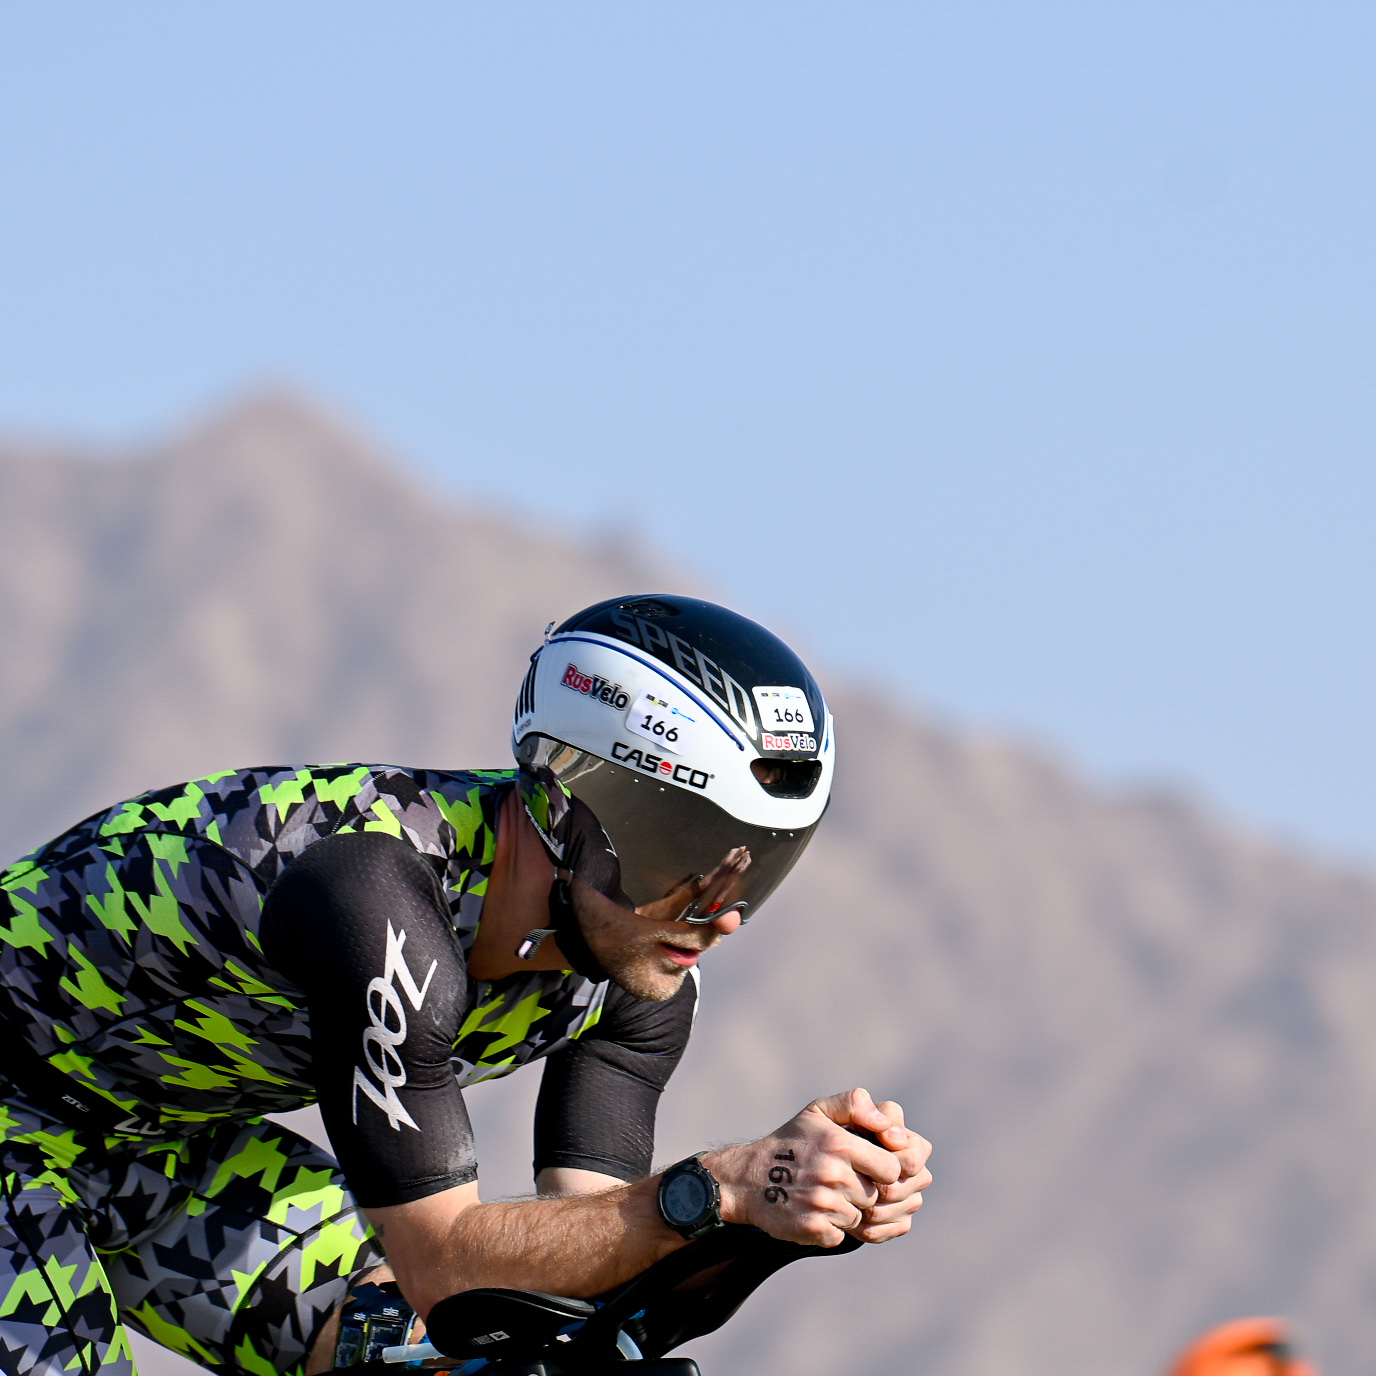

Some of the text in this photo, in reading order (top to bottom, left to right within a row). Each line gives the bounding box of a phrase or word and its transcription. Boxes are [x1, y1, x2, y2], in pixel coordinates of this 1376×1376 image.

[561, 664, 630, 710] RusVelo
[610, 609, 759, 742] SPEED
[640, 714, 679, 742] 166
[774, 707, 804, 723] 166
[764, 734, 815, 750] RusVelo
[765, 1148, 796, 1205] 166
